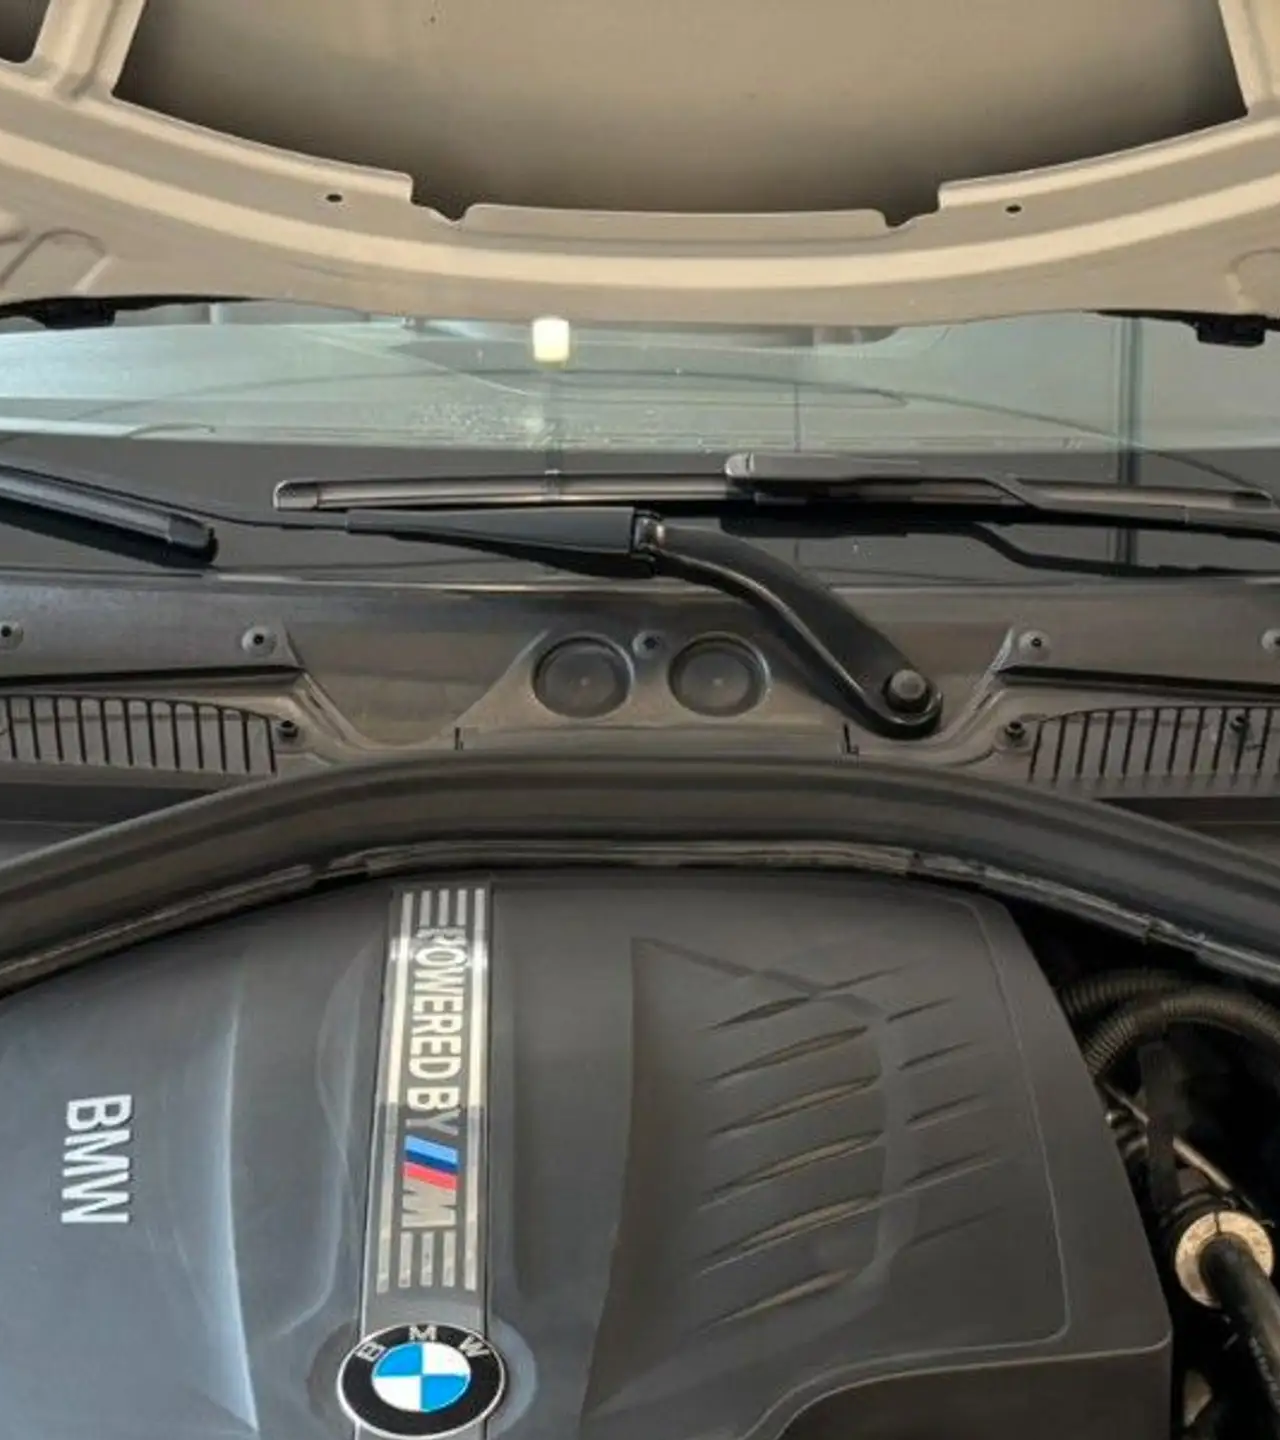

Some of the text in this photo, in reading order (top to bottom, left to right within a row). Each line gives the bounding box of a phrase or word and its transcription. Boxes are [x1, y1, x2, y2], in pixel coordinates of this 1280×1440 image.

[409, 928, 468, 1080] POWERED
[406, 1085, 462, 1137] BY
[61, 1093, 132, 1224] BMW
[355, 1325, 490, 1363] BMW
